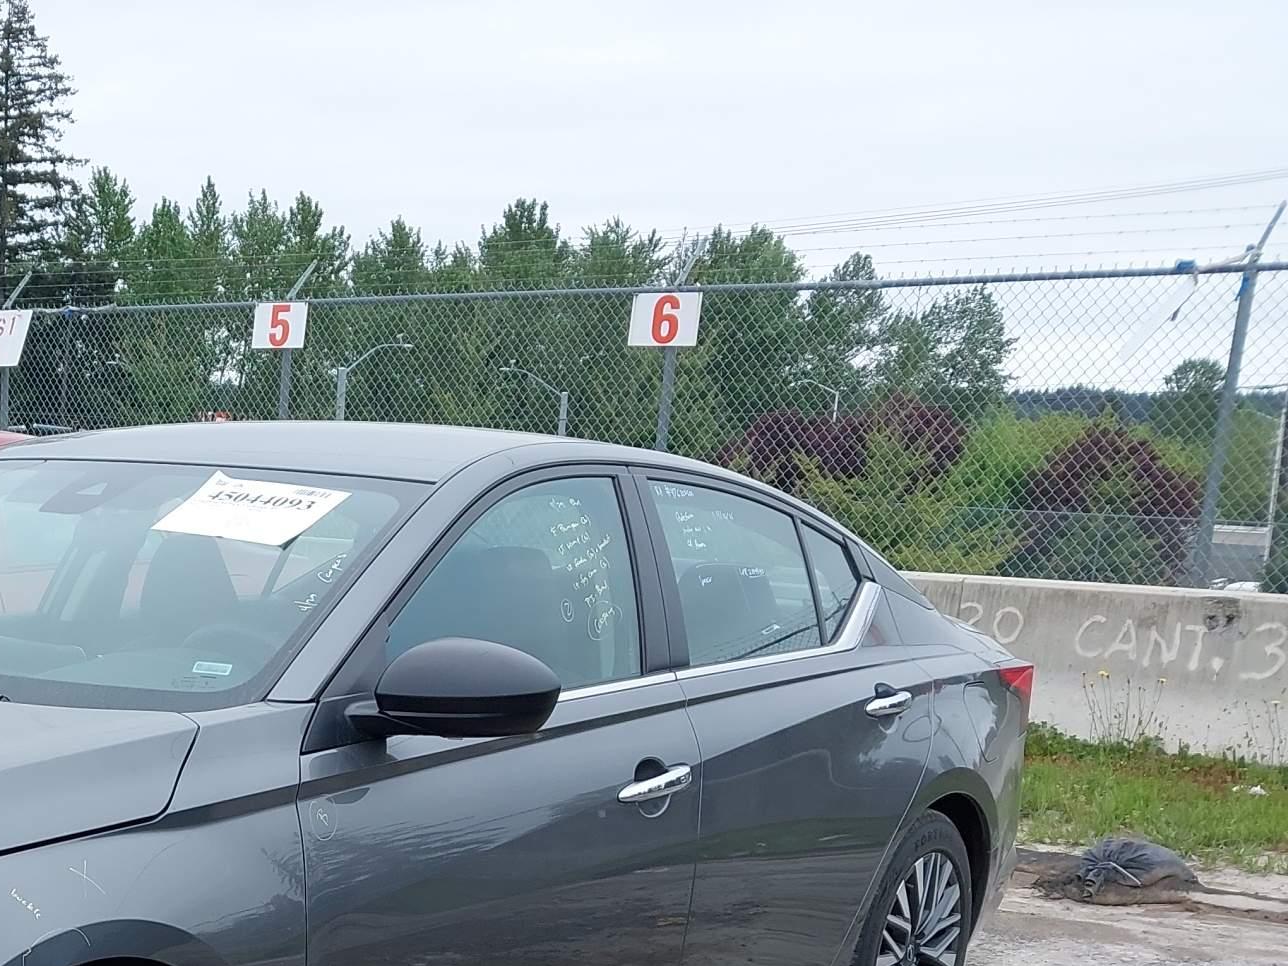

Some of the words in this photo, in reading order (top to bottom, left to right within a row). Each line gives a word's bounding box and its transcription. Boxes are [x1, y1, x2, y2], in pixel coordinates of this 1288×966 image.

[268, 304, 291, 347] 5
[650, 294, 681, 344] 6
[208, 490, 317, 511] 45044093
